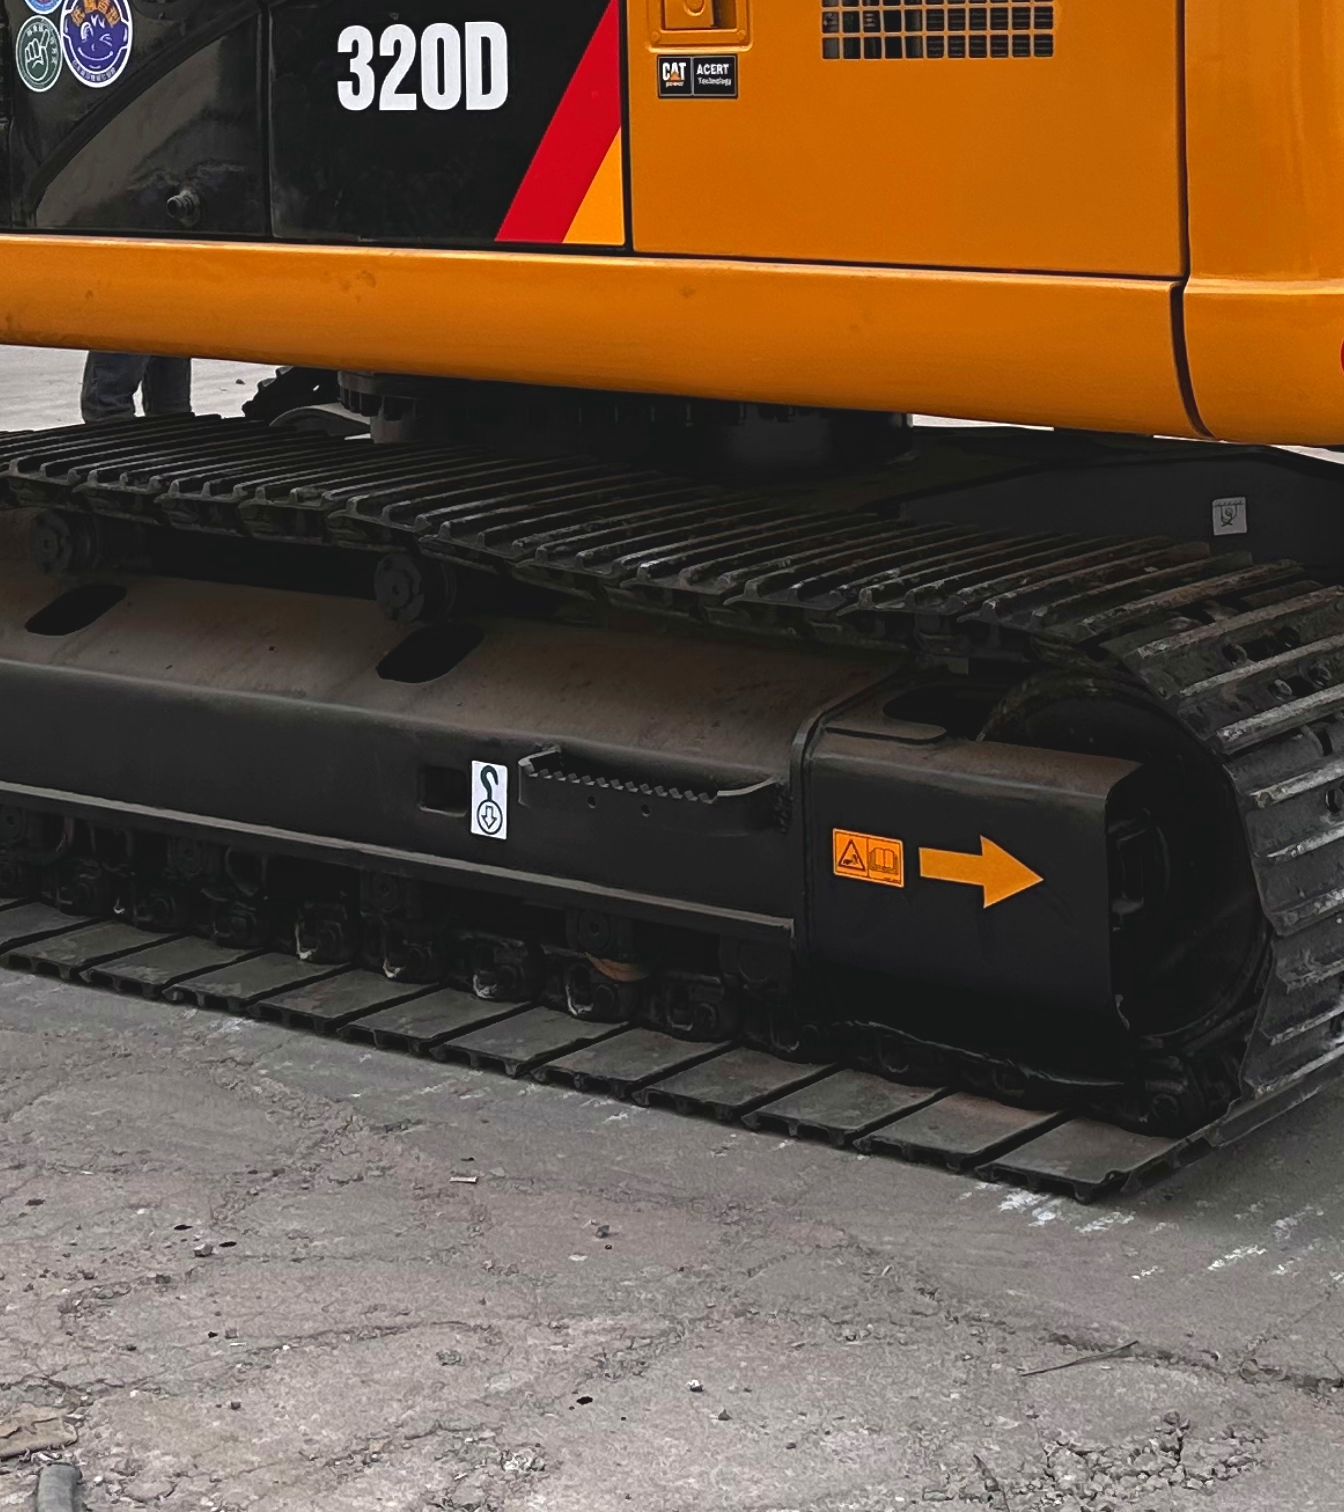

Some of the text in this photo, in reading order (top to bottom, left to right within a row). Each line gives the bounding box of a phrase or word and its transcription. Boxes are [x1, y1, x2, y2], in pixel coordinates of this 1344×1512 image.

[337, 21, 508, 111] 320D
[662, 62, 686, 81] CAT
[696, 63, 730, 75] ACERT
